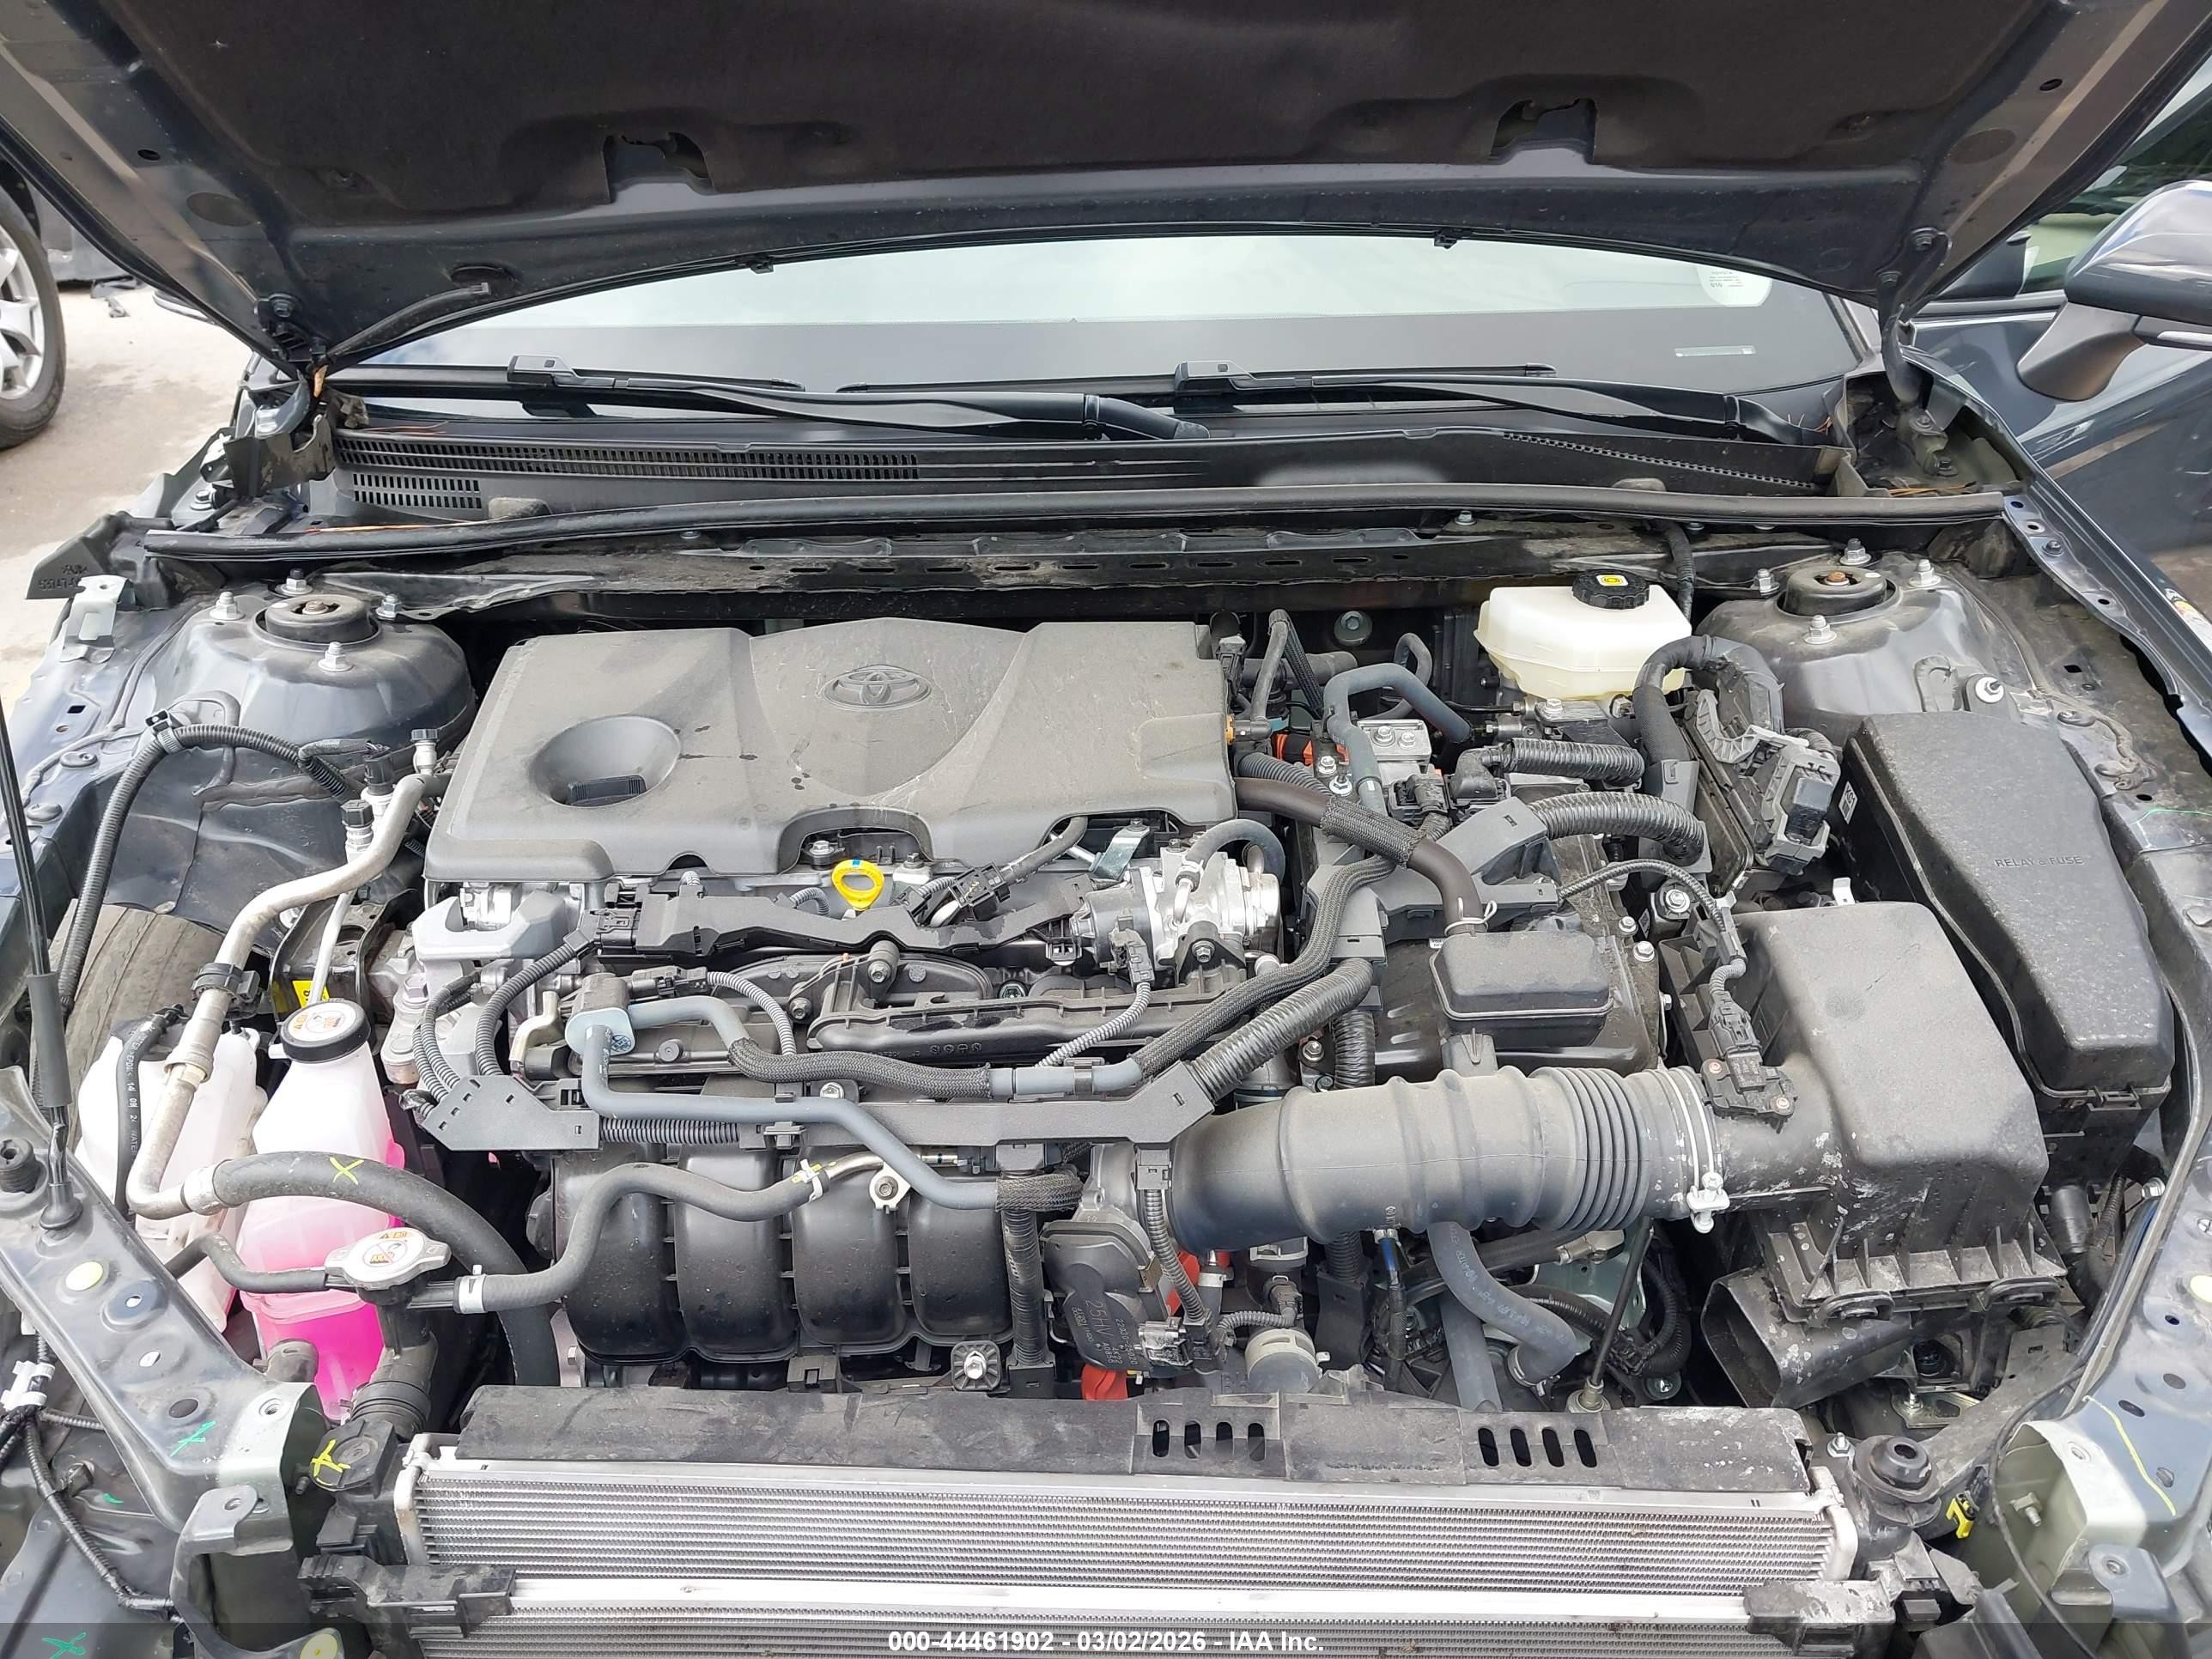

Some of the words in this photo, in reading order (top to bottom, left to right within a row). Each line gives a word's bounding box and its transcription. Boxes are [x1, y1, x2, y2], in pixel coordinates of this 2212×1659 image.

[1994, 858, 2035, 867] RELAY
[2049, 855, 2085, 866] FUSE
[1085, 1299, 1114, 1336] 25HV
